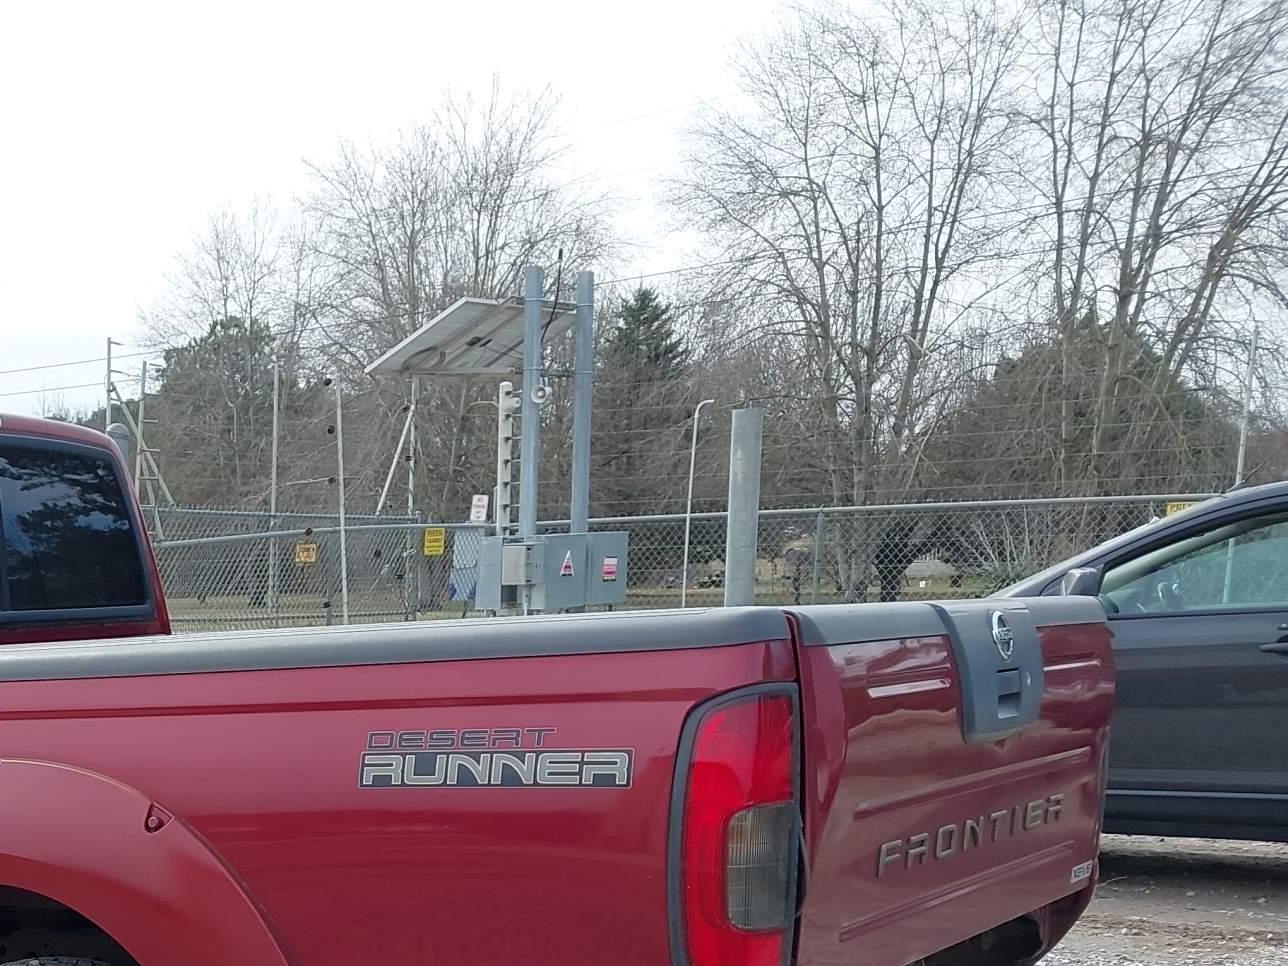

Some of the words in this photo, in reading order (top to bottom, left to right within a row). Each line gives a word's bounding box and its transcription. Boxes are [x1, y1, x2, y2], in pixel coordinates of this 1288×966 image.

[366, 727, 557, 750] DESERT
[362, 751, 630, 786] RUNNER
[876, 793, 1065, 879] FRONTIER
